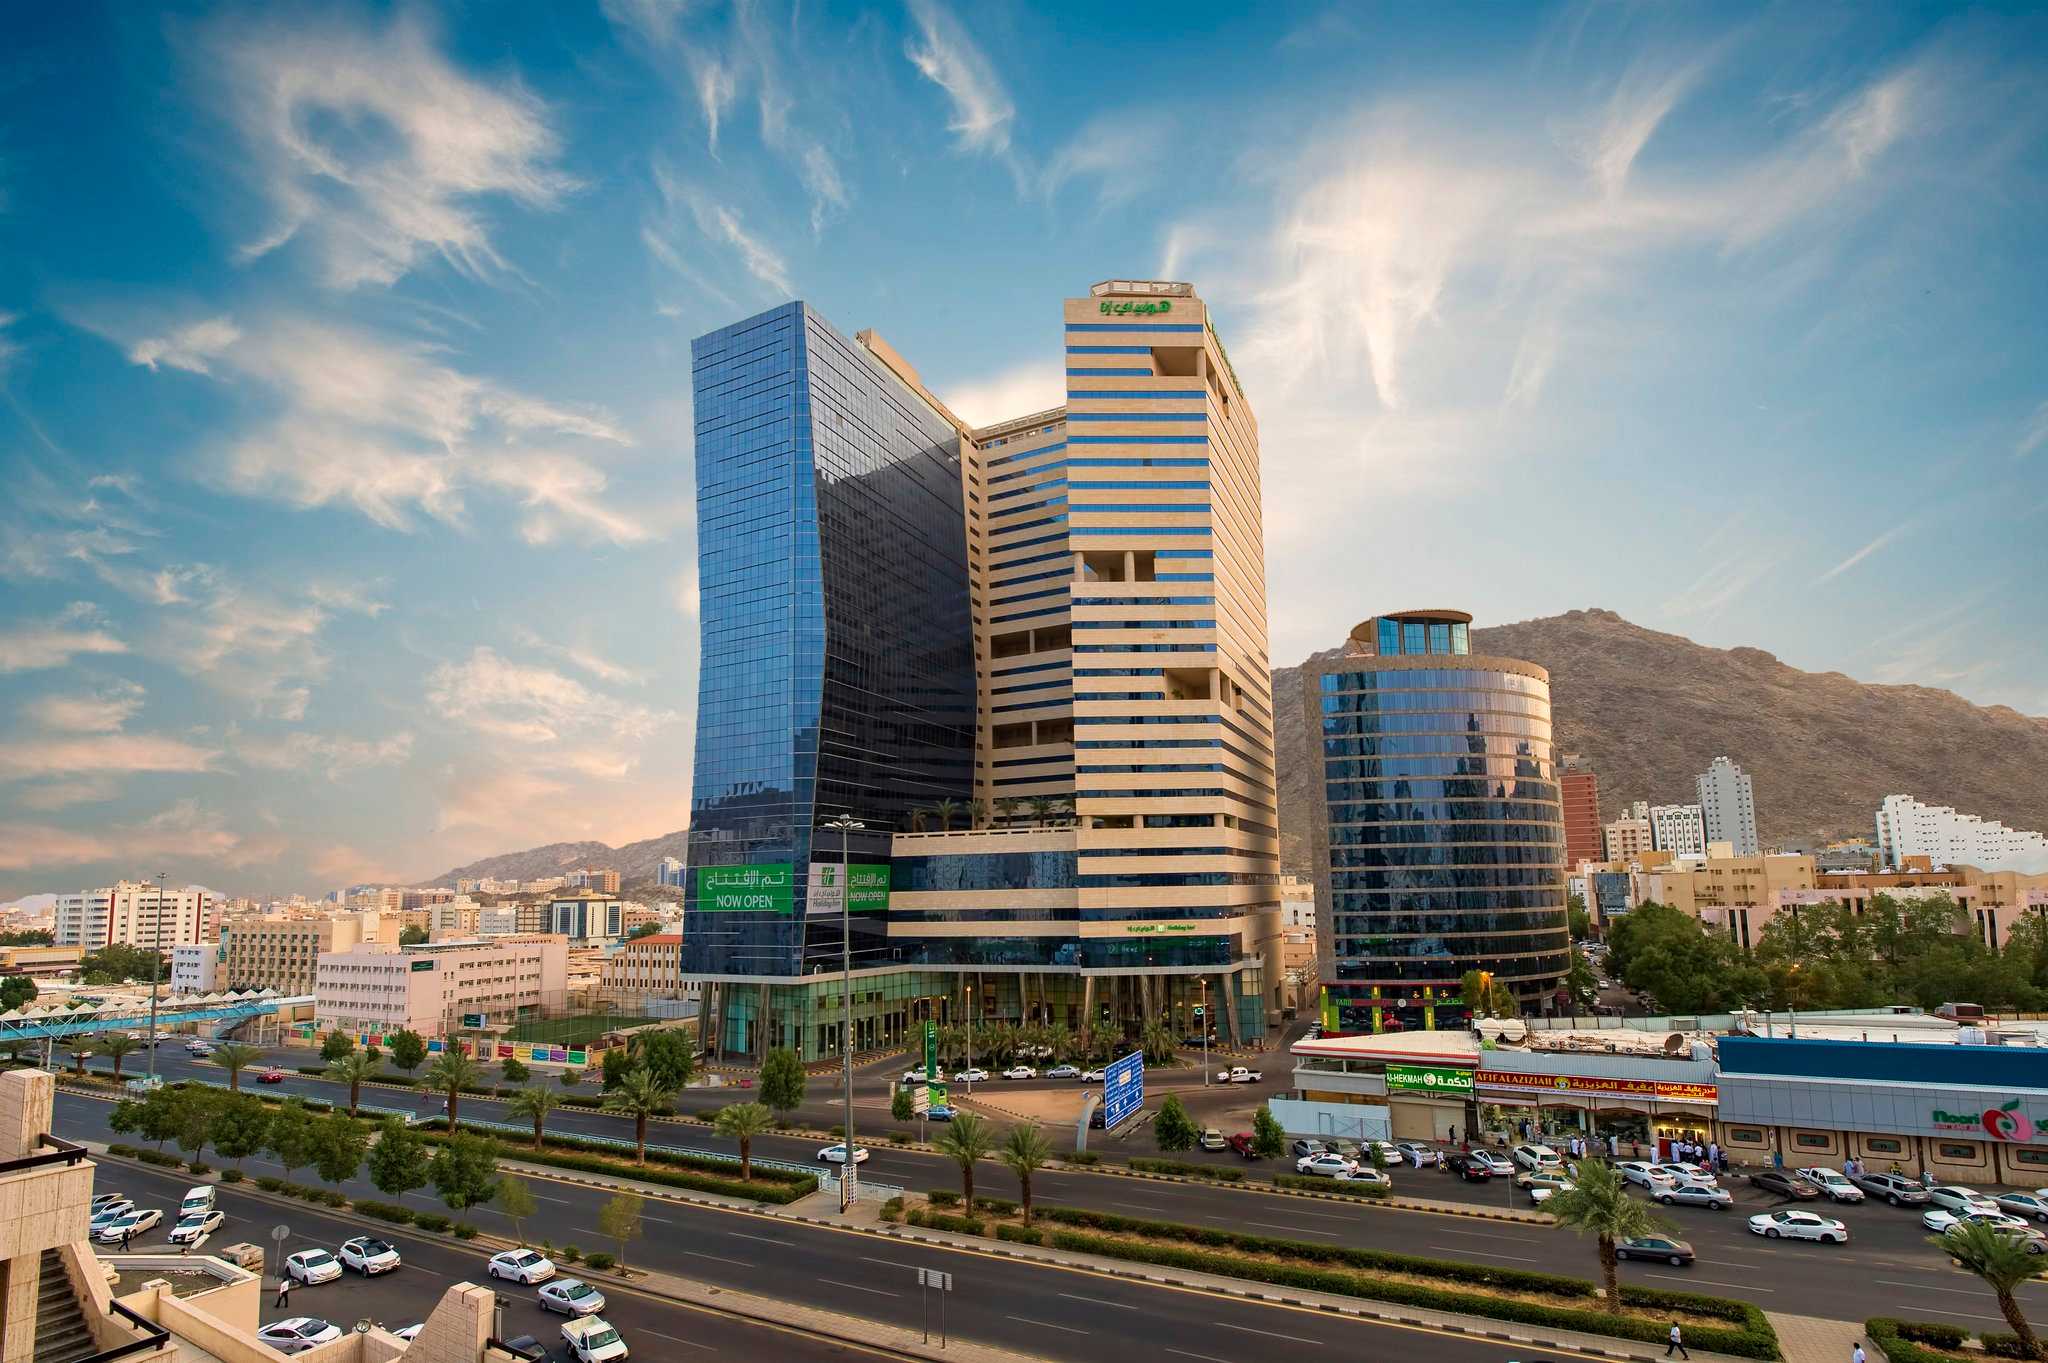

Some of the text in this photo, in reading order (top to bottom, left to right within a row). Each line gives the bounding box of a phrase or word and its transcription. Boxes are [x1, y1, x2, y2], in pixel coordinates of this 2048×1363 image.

[706, 870, 784, 889] تم الإفتتاح
[716, 895, 773, 907] NOW OPEN
[850, 890, 886, 902] NOW OPEN
[1437, 1075, 1474, 1087] الحكمة
